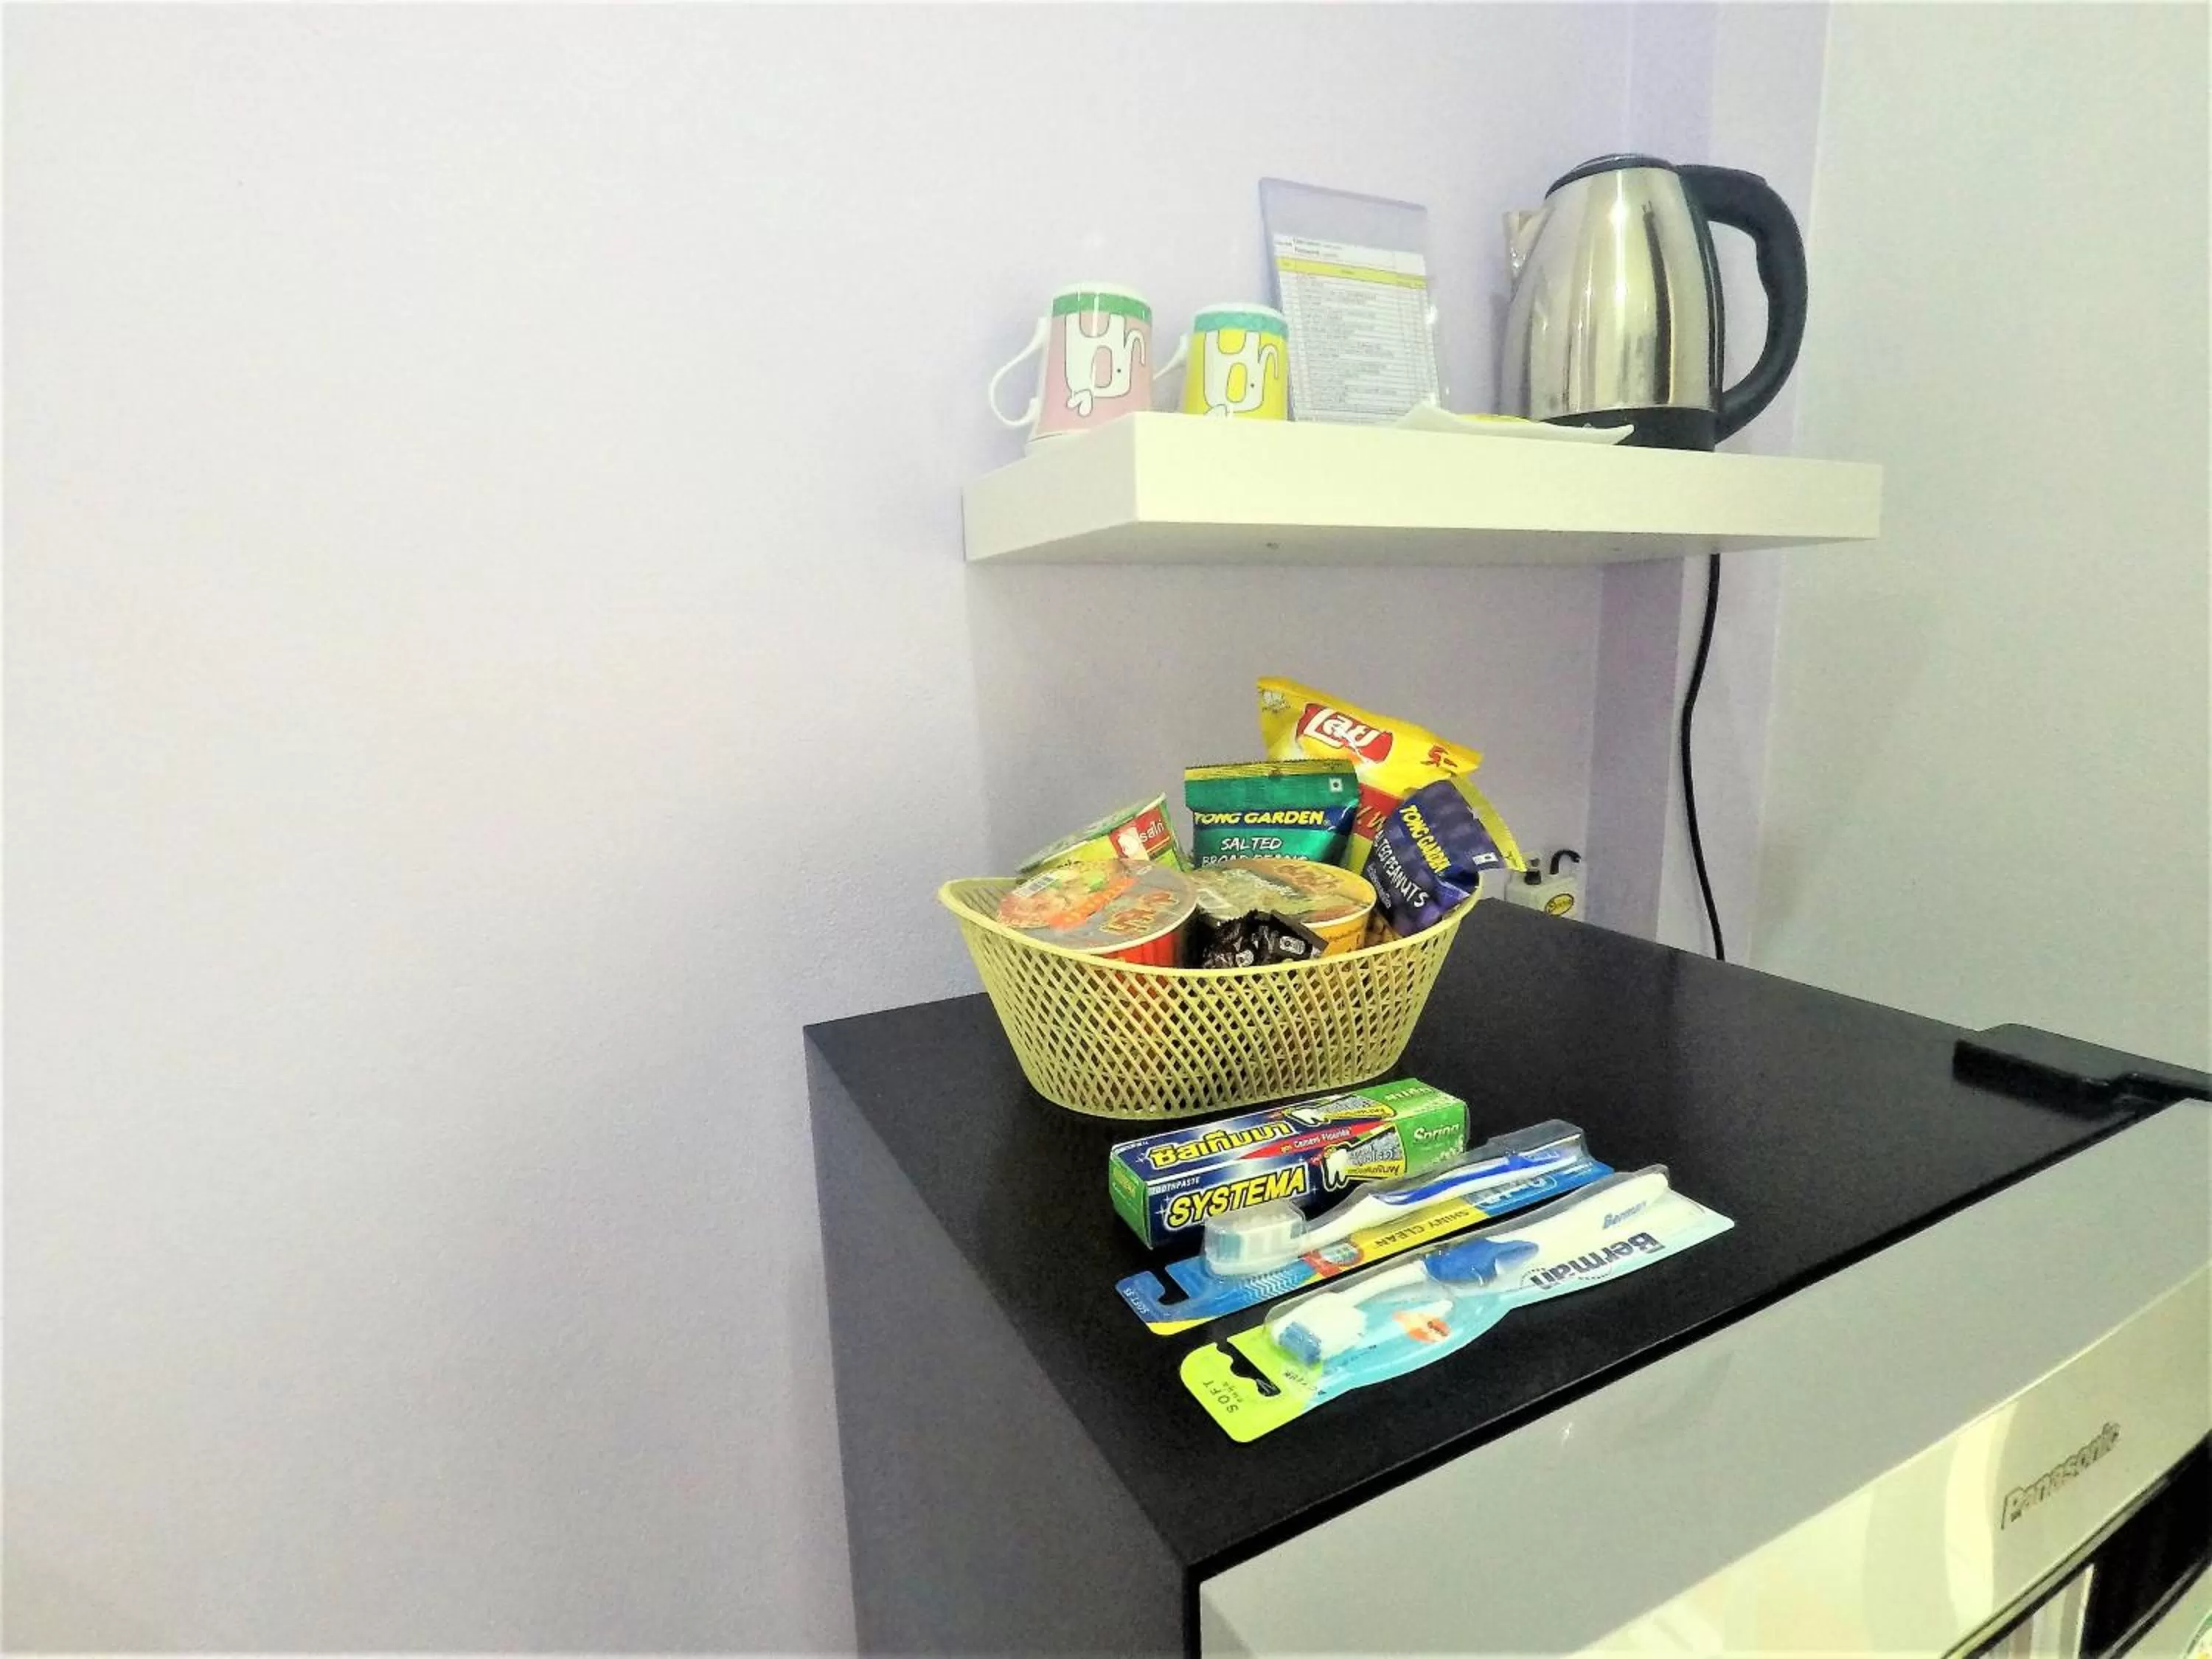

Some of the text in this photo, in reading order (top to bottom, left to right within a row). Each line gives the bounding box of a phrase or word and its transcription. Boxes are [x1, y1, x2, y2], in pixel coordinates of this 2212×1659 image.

[1194, 811, 1324, 825] TONG GARDEN
[1399, 804, 1429, 840] TONG
[1221, 838, 1283, 850] SALTED
[1384, 855, 1429, 908] PEANUTS
[1152, 1176, 1200, 1195] TOOTHPASTE
[1167, 1165, 1306, 1228] SYSTEMA
[1376, 1224, 1425, 1248] CLEAN
[1531, 1231, 1666, 1290] Berman
[1203, 1379, 1239, 1413] SOFT
[2000, 1421, 2121, 1531] Panasonic
